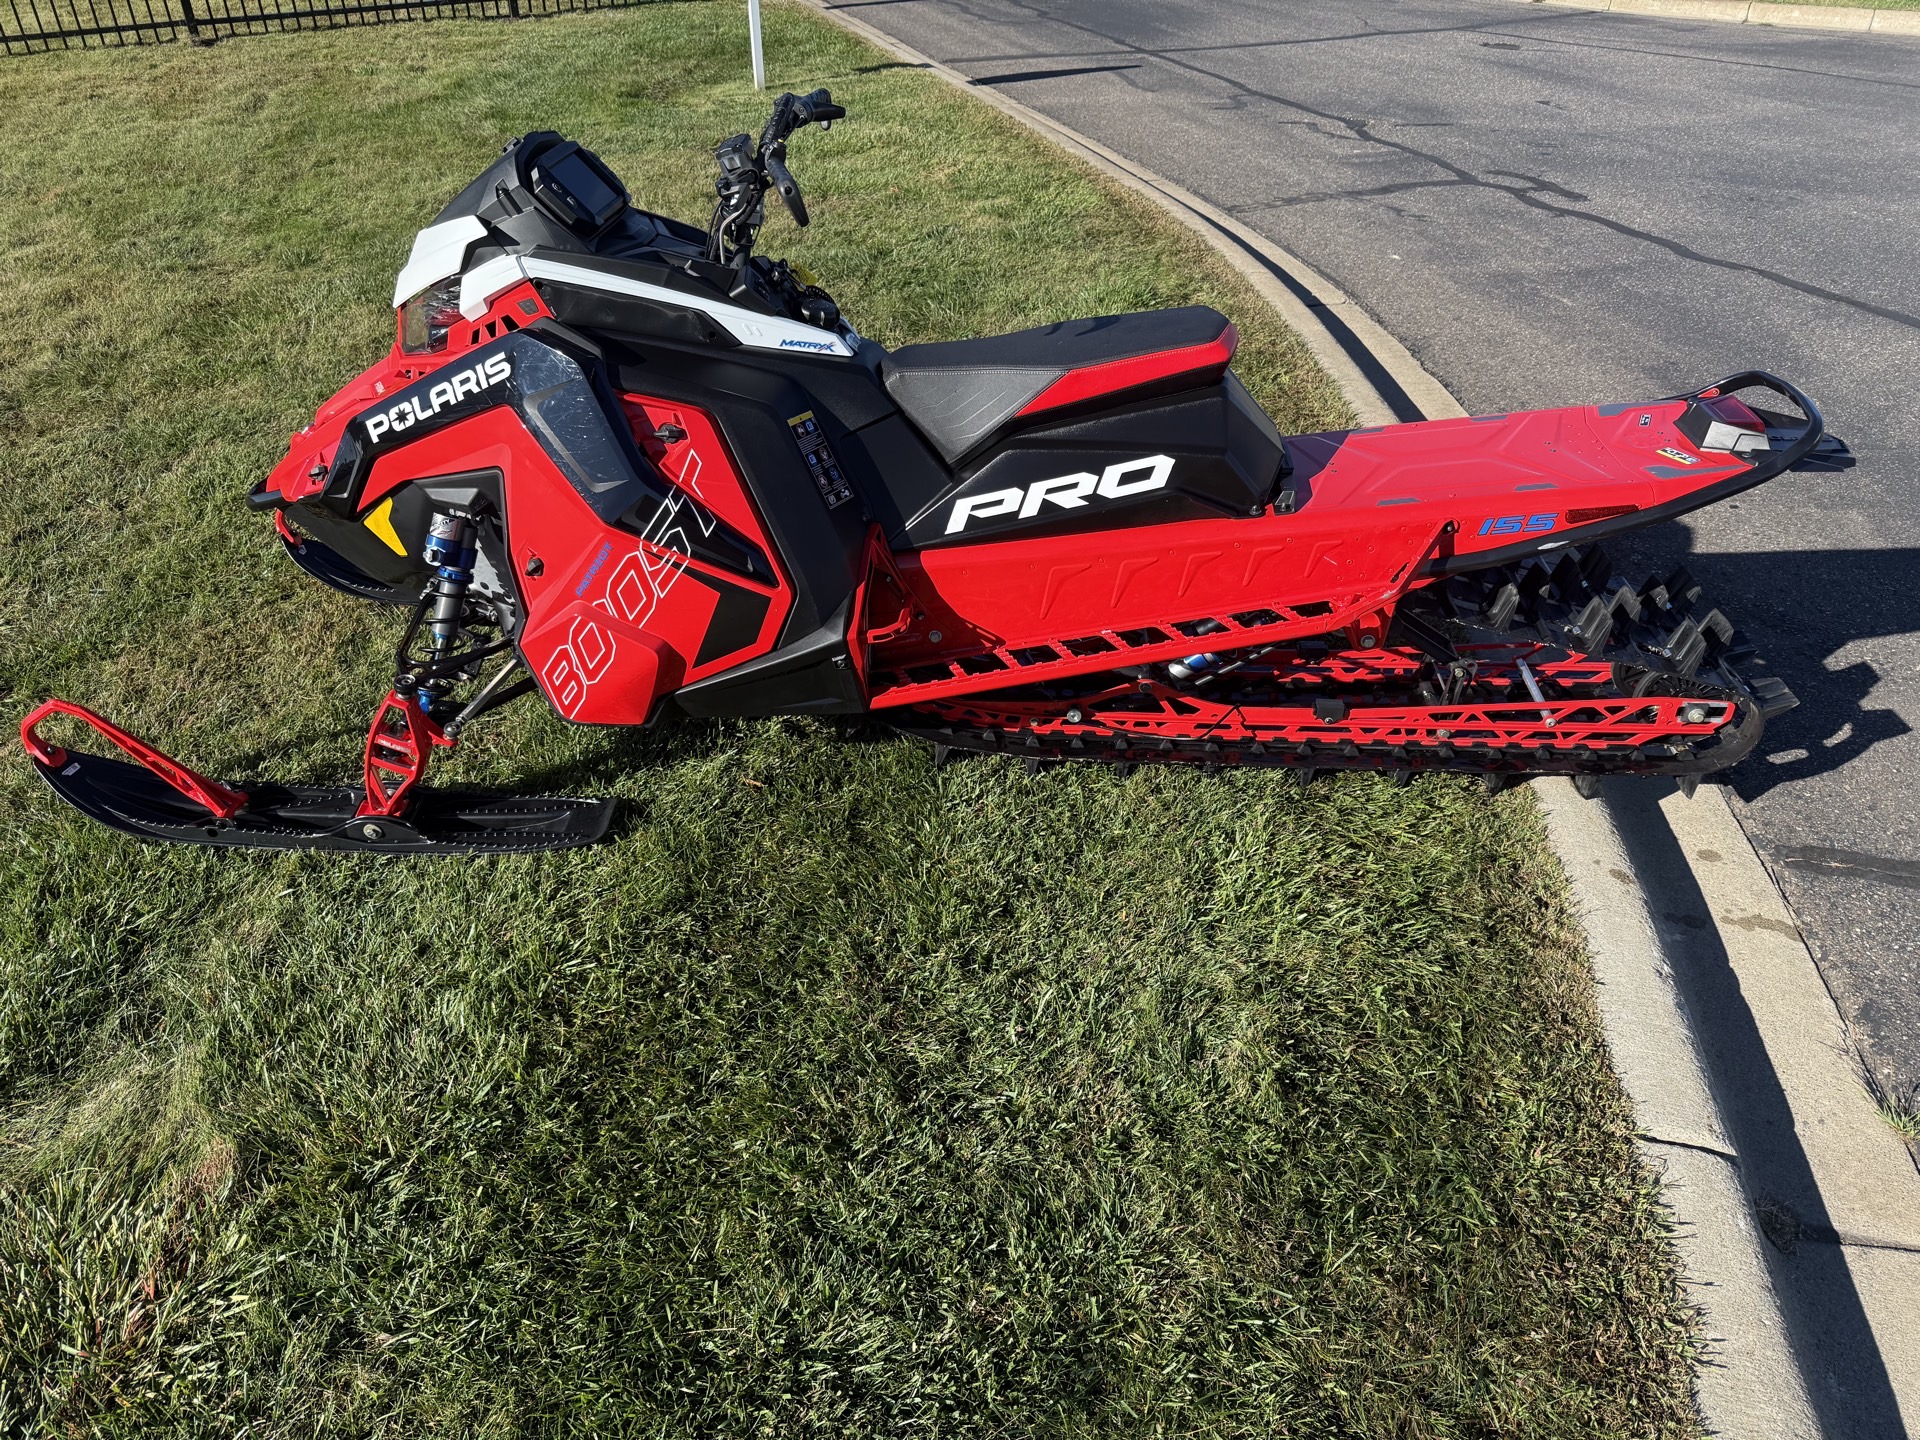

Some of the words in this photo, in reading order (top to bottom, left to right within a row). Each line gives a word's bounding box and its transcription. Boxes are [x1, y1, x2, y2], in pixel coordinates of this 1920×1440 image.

[780, 339, 836, 353] MATRYX
[365, 351, 511, 444] POLARIS
[944, 454, 1176, 535] PRO
[1477, 512, 1560, 536] 155
[542, 449, 717, 719] BOOST
[575, 540, 614, 598] PATRIOT
